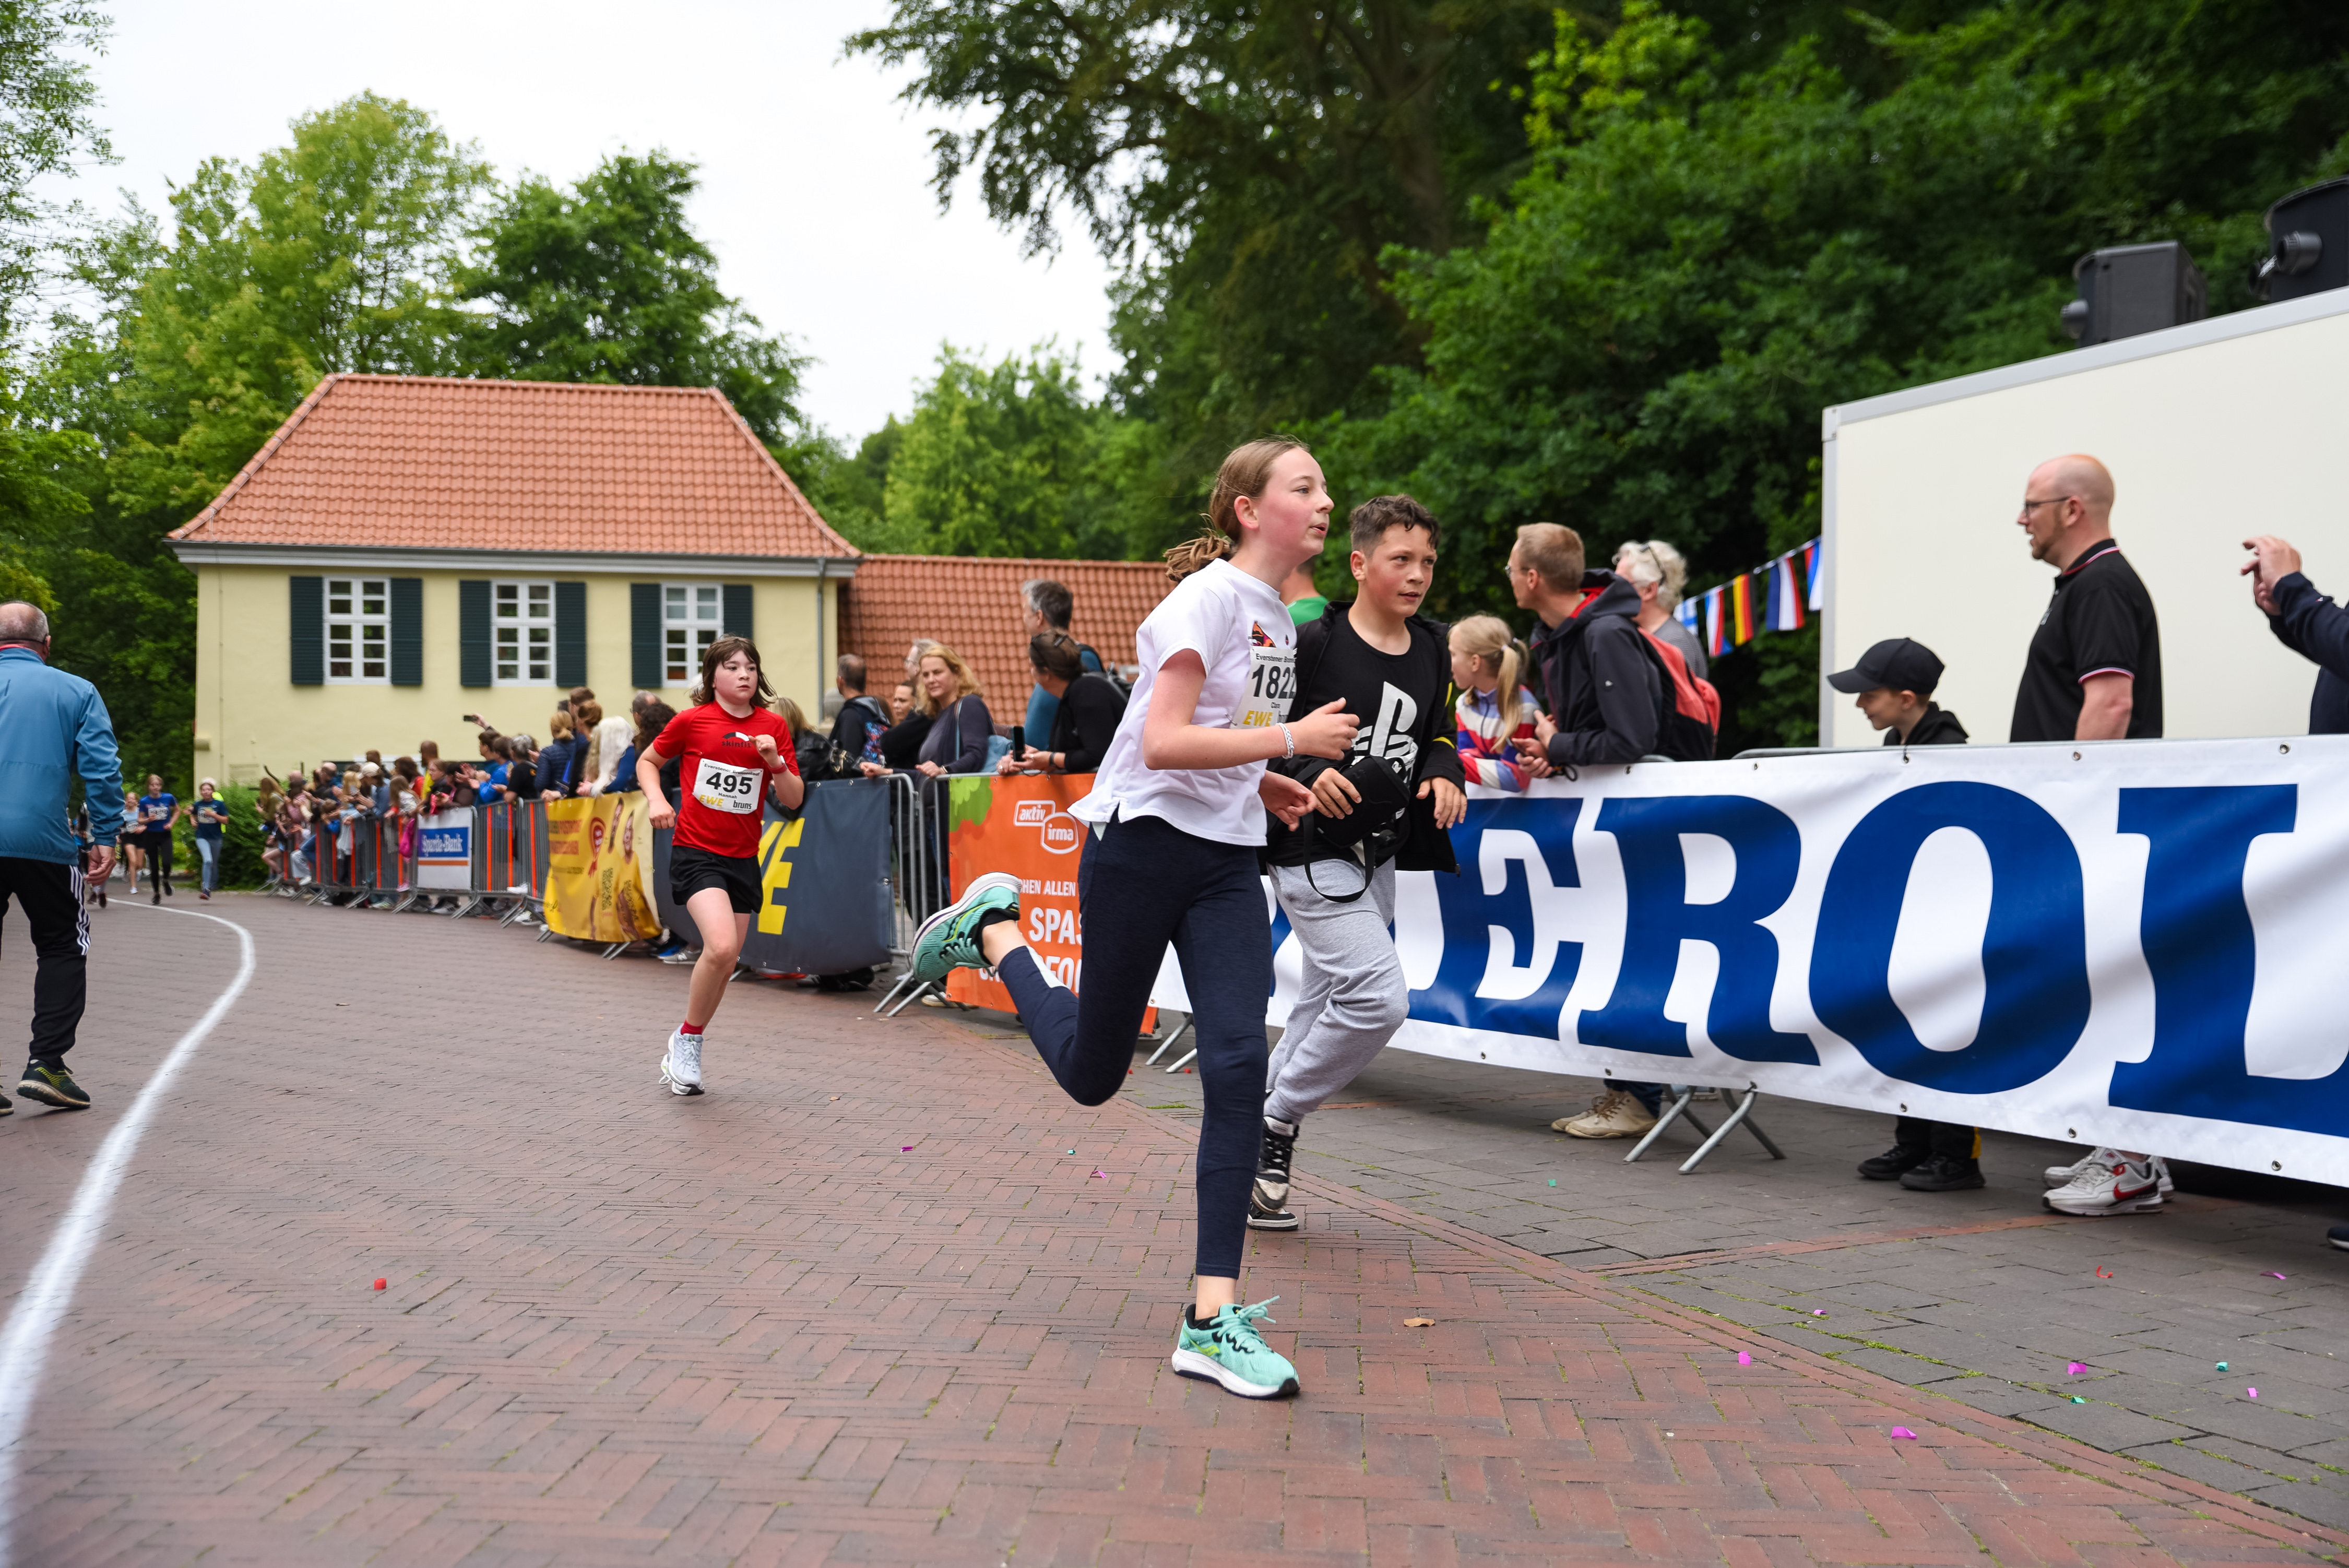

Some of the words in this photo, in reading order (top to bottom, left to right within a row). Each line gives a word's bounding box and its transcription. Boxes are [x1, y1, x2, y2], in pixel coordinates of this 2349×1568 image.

[1243, 710, 1274, 727] EWE
[706, 772, 753, 795] 495
[699, 794, 724, 807] EWE
[733, 800, 753, 809] bruns
[1019, 804, 1046, 821] aktiv
[1048, 823, 1074, 841] irma
[1021, 878, 1041, 895] HEN
[1043, 880, 1076, 896] ALLEN
[1270, 781, 2349, 1137] EROL
